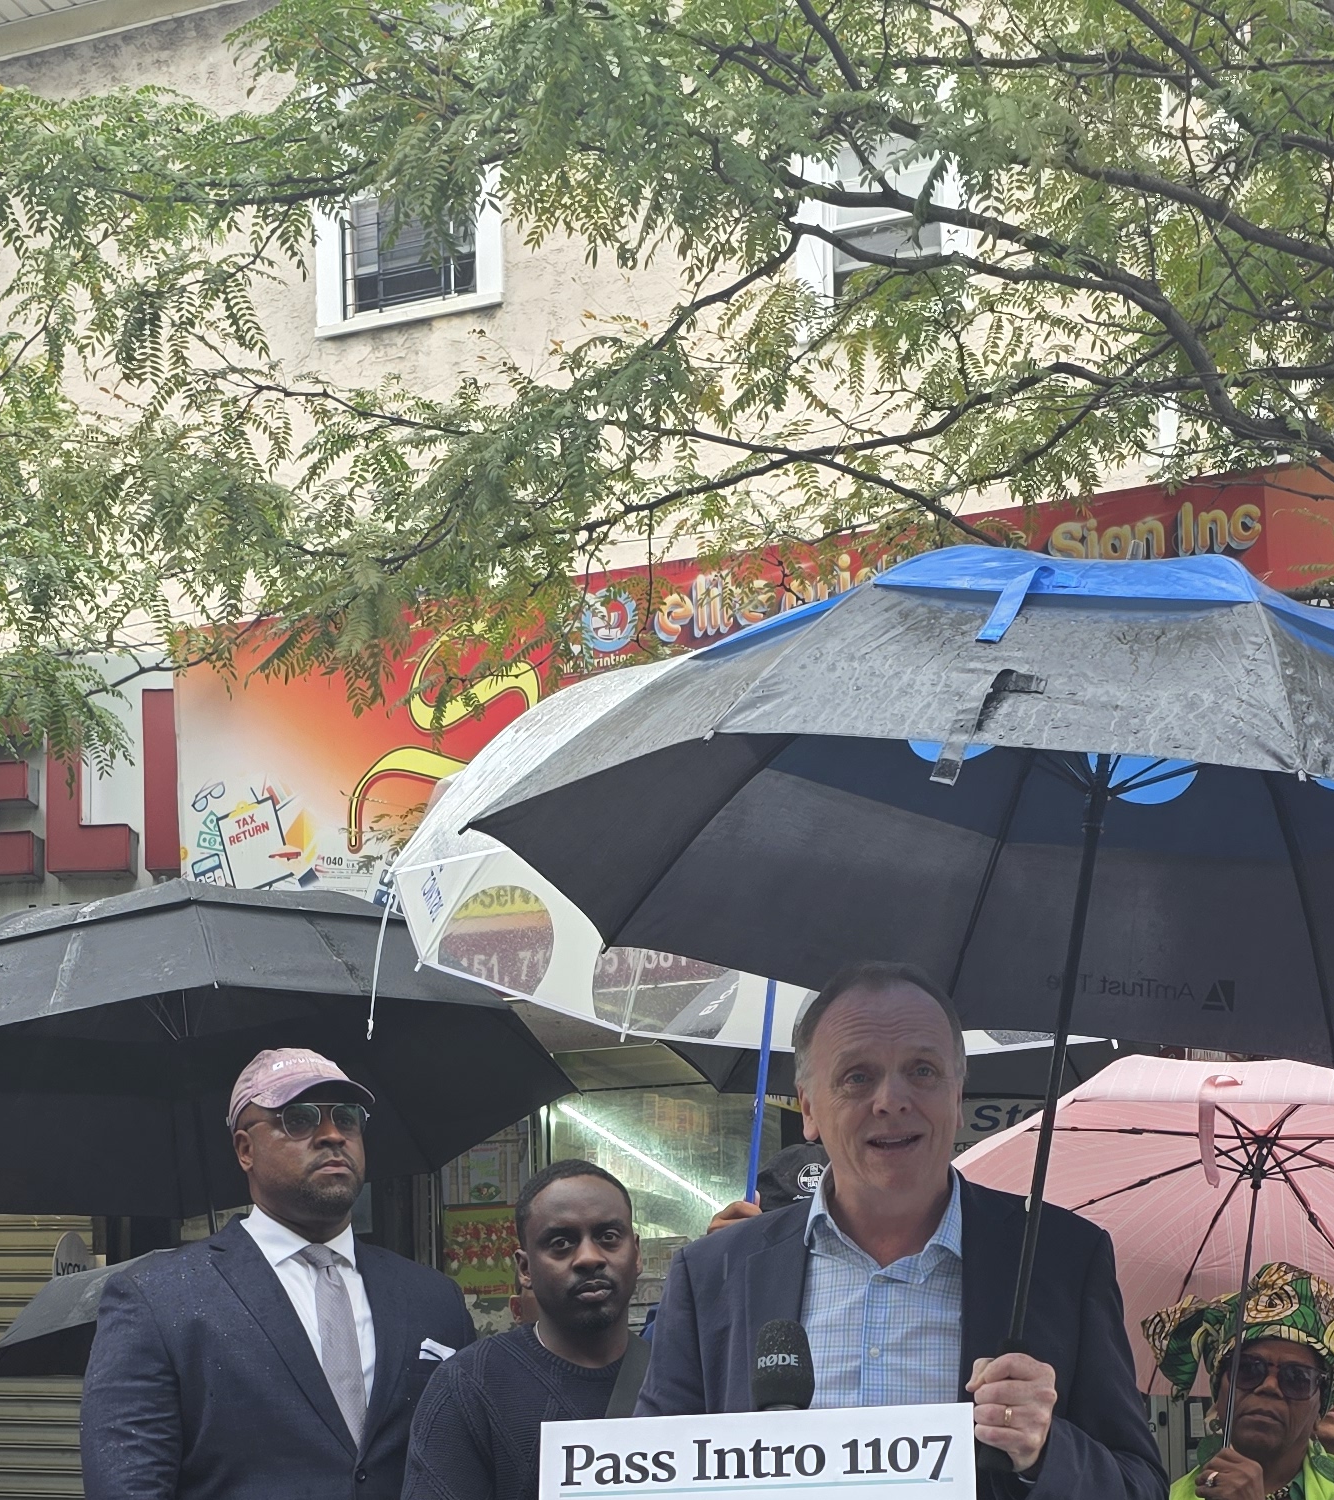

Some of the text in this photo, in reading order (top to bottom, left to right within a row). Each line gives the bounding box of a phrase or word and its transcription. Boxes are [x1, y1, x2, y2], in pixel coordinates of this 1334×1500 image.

[1048, 501, 1262, 560] Sign Inc
[228, 821, 270, 847] RETURN
[234, 813, 257, 830] TAX
[756, 1353, 800, 1370] RØDE
[560, 1435, 953, 1487] Pass Intro 1107
